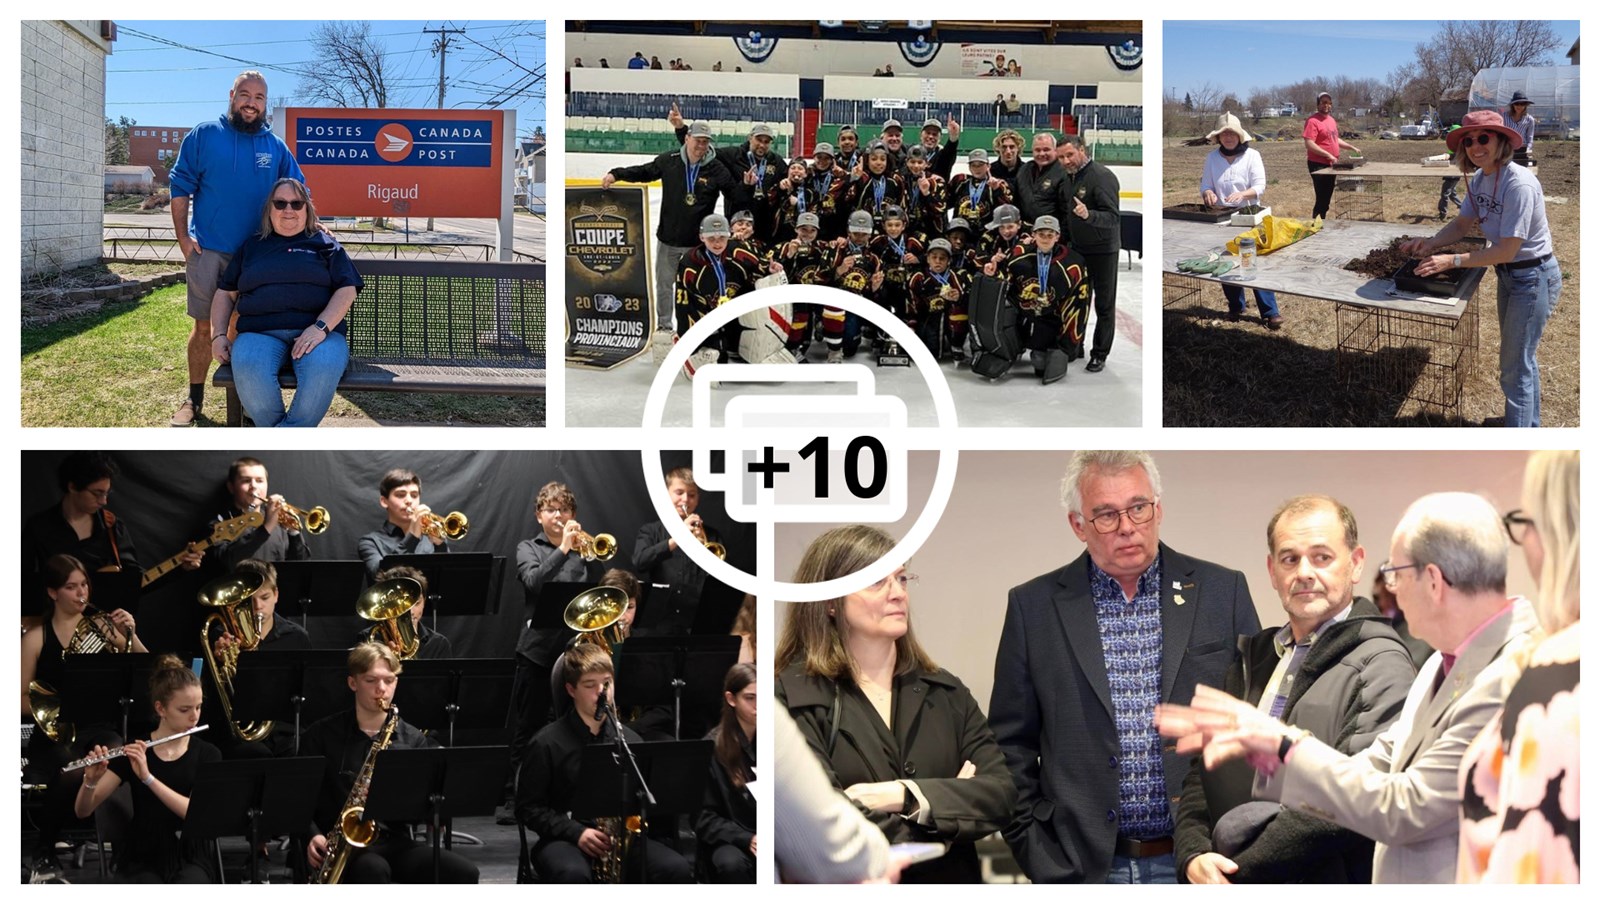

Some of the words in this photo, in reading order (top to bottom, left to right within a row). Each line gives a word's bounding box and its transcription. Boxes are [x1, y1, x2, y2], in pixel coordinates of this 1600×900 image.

[306, 126, 362, 136] POSTES
[419, 127, 483, 138] CANADA
[305, 148, 369, 159] CANADA
[419, 150, 456, 160] POST
[367, 184, 418, 203] Rigaud
[575, 229, 626, 246] COUPE
[568, 246, 635, 255] CHEVROLET
[575, 296, 591, 309] 20
[624, 298, 640, 311] 23
[576, 318, 644, 336] CHAMPIONS
[573, 332, 642, 348] PROVINCIAUX
